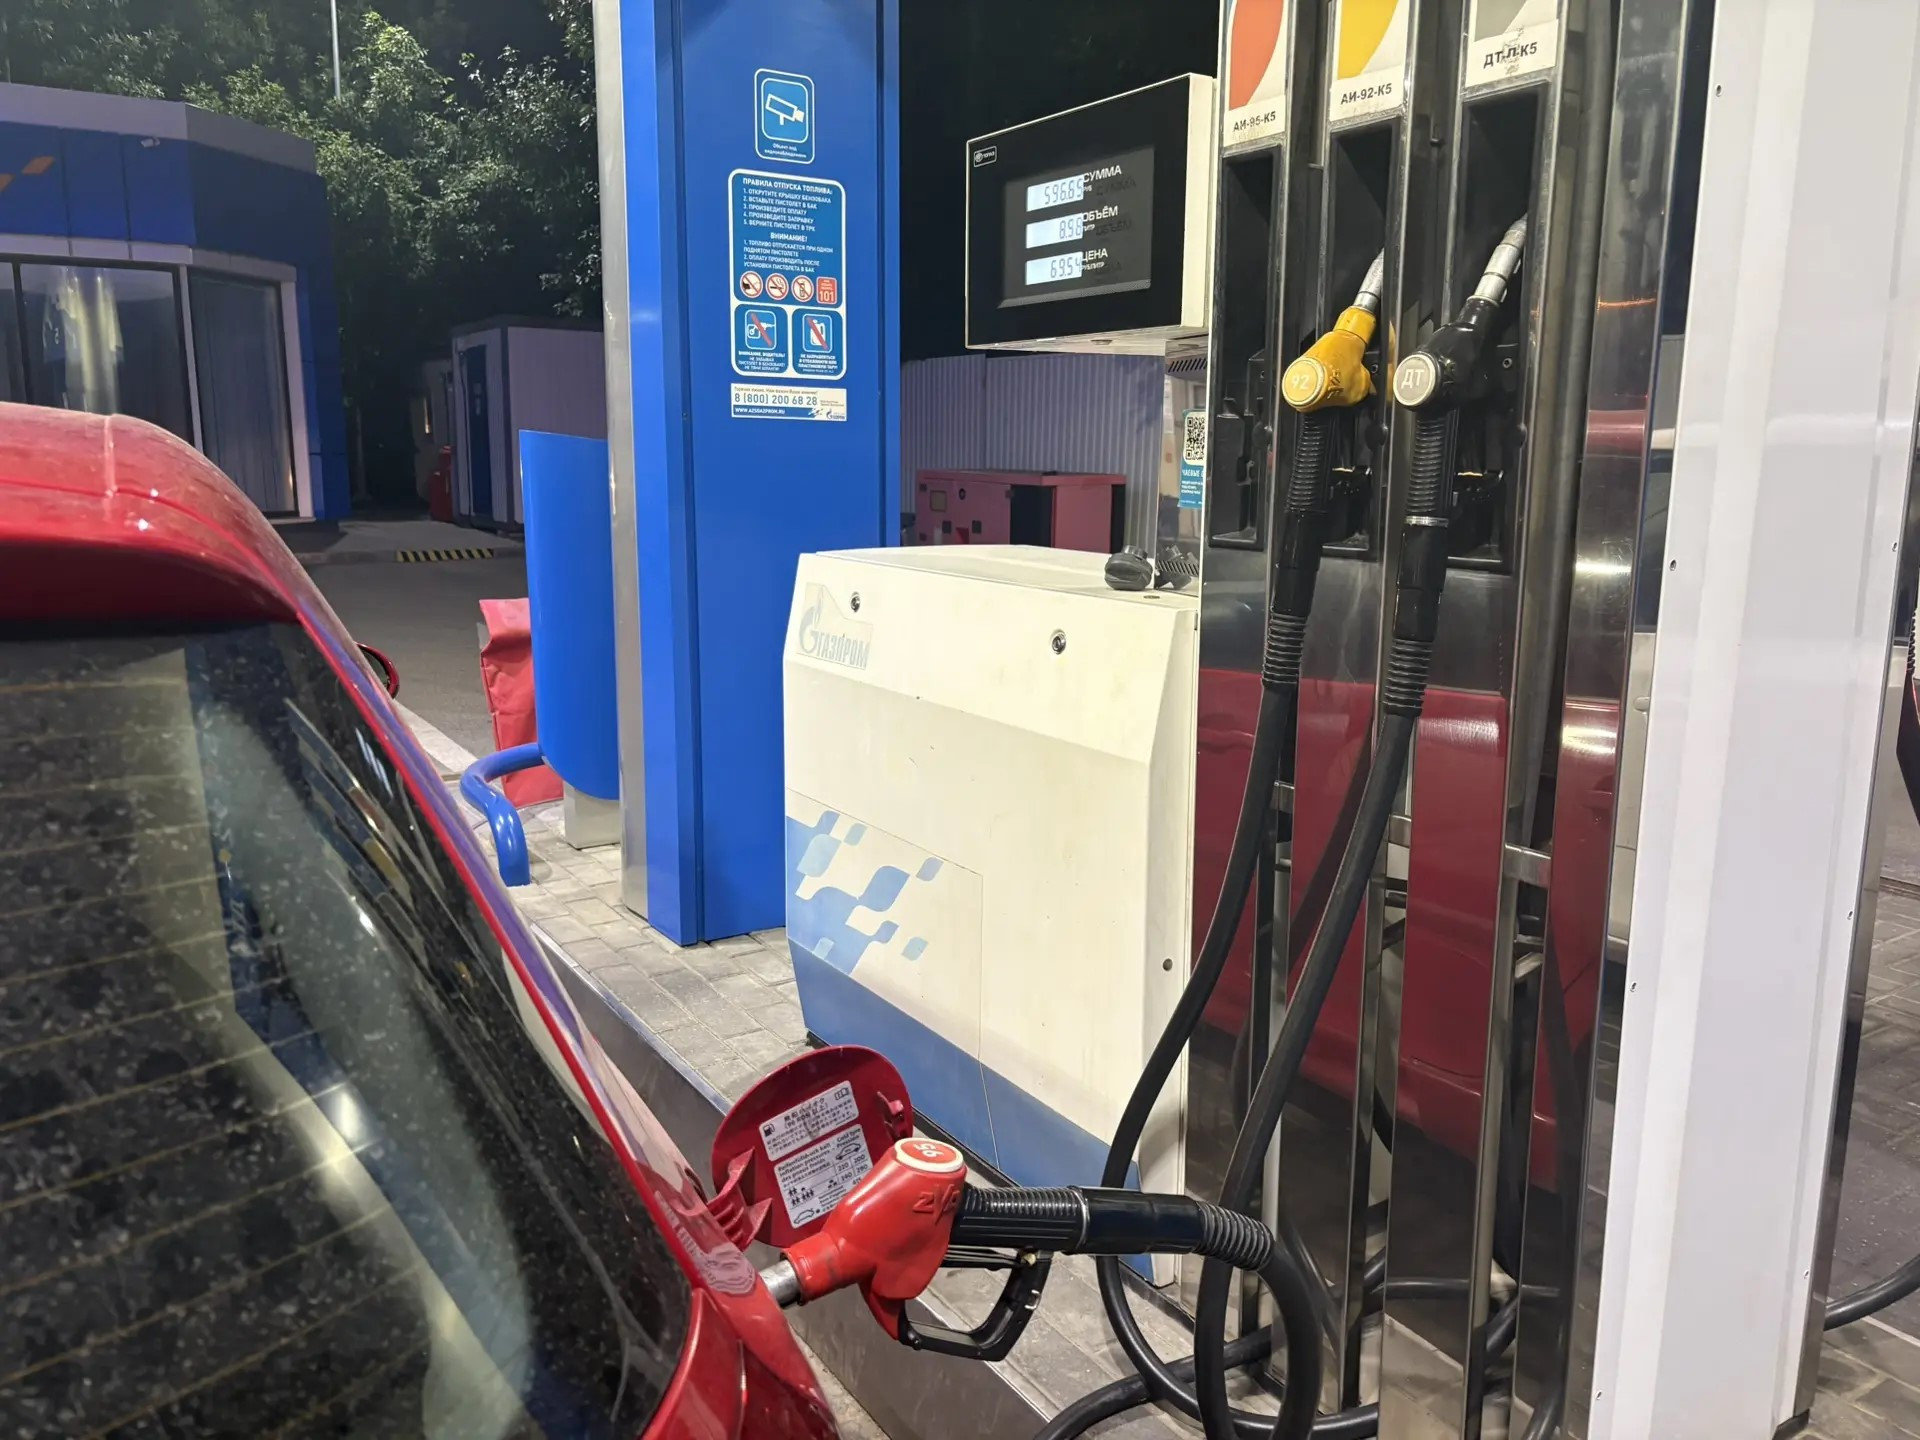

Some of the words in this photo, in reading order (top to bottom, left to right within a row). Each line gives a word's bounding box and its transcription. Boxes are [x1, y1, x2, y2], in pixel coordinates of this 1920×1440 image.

[1340, 83, 1392, 105] АИ-92-К5
[1233, 111, 1276, 132] АИ-95-К5
[1083, 165, 1122, 182] СУММА
[743, 178, 772, 188] ПРАВИЛА
[774, 181, 801, 190] ОТПУСКА
[802, 185, 832, 194] ТОПЛИВА:
[748, 188, 777, 197] ОТКРУТИТЕ
[802, 194, 832, 203] БЕНЗОБАКА
[748, 204, 786, 214] ПРОИЗВЕДИТЕ
[1082, 206, 1118, 222] ОБЪЁМ
[748, 212, 786, 221] ПРОИЗВЕДИТЕ
[788, 216, 814, 224] ЗАПРАВКУ
[774, 222, 800, 230] ПИСТОЛЕТ
[770, 232, 808, 242] ВНИМАНИЕ!
[772, 242, 805, 250] ОТПУСКАЕТСЯ
[768, 256, 803, 264] ПРОИЗВОДИТЬ
[1082, 248, 1108, 262] ЦЕНА
[820, 290, 834, 302] 101
[1290, 374, 1310, 390] 92
[1401, 369, 1425, 389] ДТ
[735, 393, 740, 402] 8
[772, 395, 789, 404] 200
[792, 396, 804, 405] 68
[806, 396, 817, 405] 28
[912, 1143, 944, 1158] 95
[838, 1162, 849, 1171] 220
[854, 1154, 865, 1163] 200
